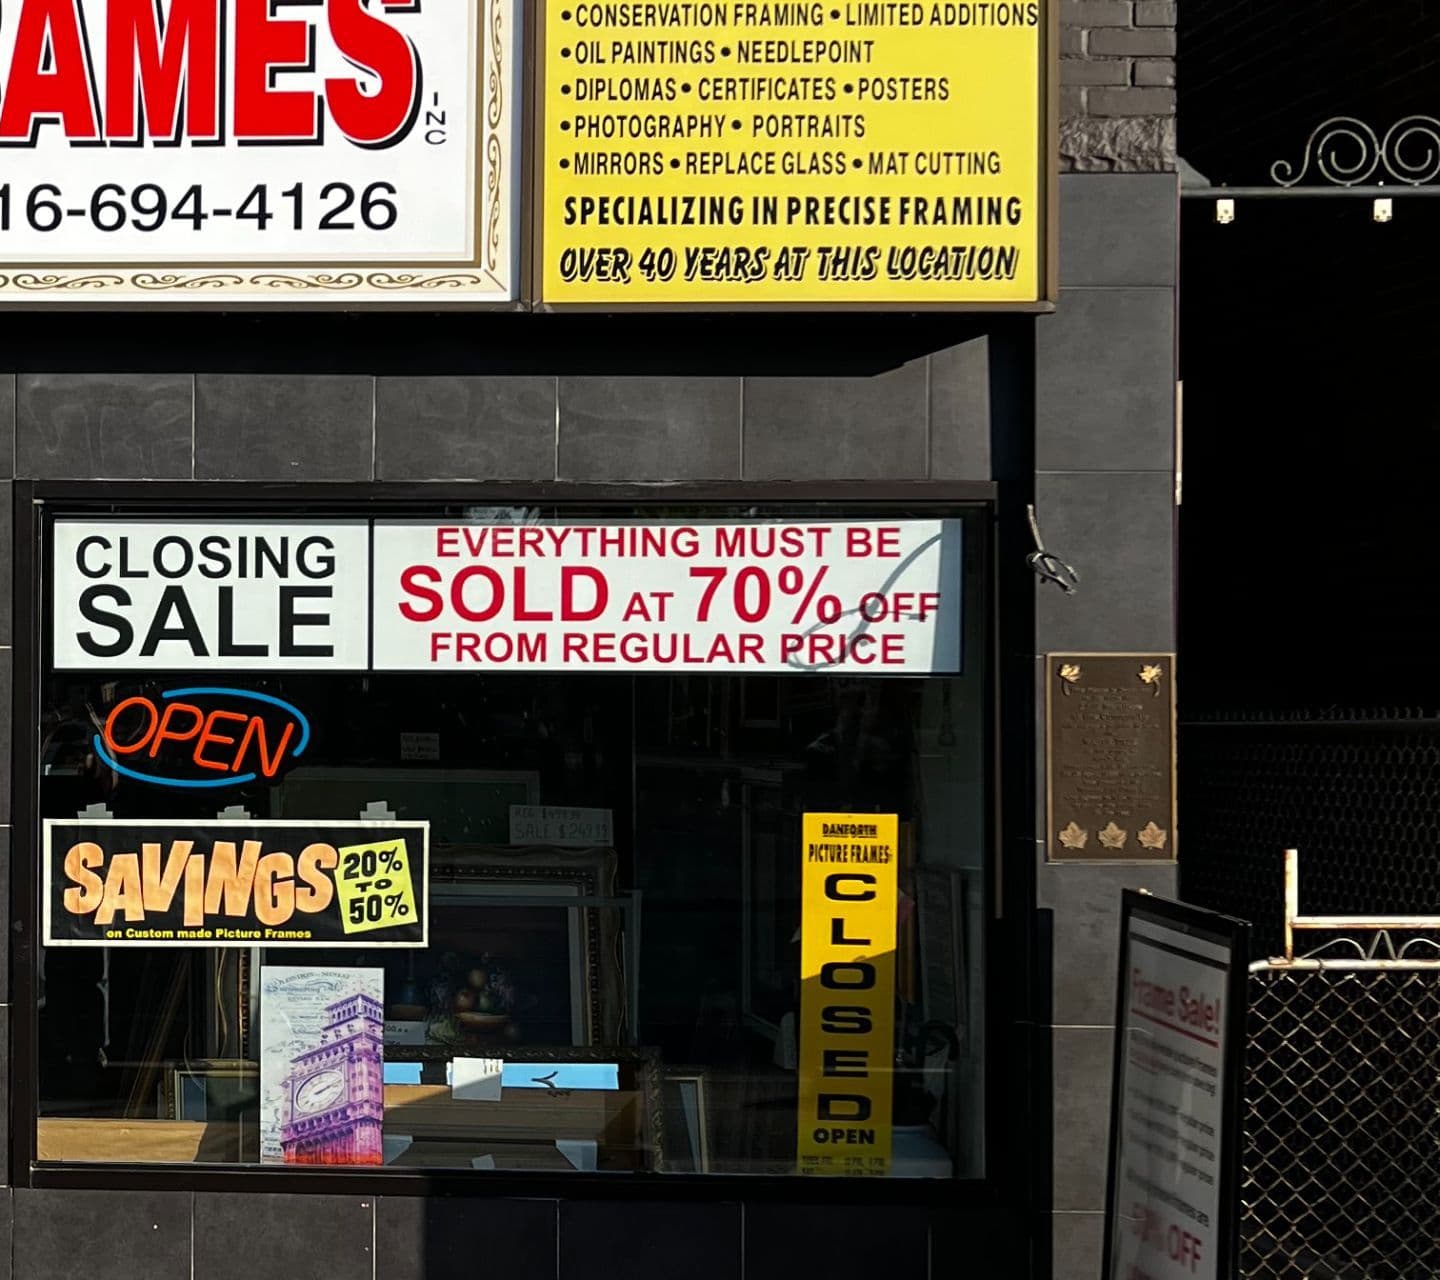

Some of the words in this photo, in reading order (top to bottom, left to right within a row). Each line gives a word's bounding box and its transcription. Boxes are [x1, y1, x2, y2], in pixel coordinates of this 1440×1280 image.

[575, 3, 728, 28] CONSERVATION
[733, 2, 825, 28] FRAMING
[845, 2, 924, 27] LIMITED
[929, 2, 1039, 27] ADDITIONS
[575, 40, 606, 65] OIL
[611, 40, 717, 65] PAINTINGS
[736, 39, 875, 65] NEEDLEPOINT
[575, 77, 677, 102] DIPLOMAS
[697, 76, 837, 102] CERTIFICATES
[857, 76, 951, 102] POSTERS
[425, 91, 447, 146] INC
[574, 115, 727, 139] PHOTOGRAPHY
[751, 114, 866, 139] PORTRAITS
[573, 152, 665, 176] MIRRORS
[685, 151, 776, 176] REPLACE
[780, 151, 848, 176] GLASS
[868, 151, 910, 176] MAT
[914, 151, 1002, 176] CUTTING
[564, 195, 745, 227] SPECIALIZING
[751, 195, 779, 227] IN
[786, 195, 892, 227] PRECISE
[898, 195, 1023, 227] FRAMING
[560, 246, 633, 285] OVER
[638, 246, 678, 284] 40
[683, 245, 771, 285] YEARS
[772, 245, 811, 284] AT
[816, 245, 882, 282] THIS
[886, 245, 1020, 281] LOCATION
[75, 535, 336, 580] CLOSING
[435, 526, 700, 559] EVERYTHING
[714, 526, 832, 558] MUST
[845, 526, 902, 558] BE
[398, 564, 610, 623] SOLD
[622, 591, 675, 622] AT
[688, 564, 843, 626] 70%
[859, 591, 942, 623] OFF
[75, 583, 335, 659] SALE
[430, 632, 548, 664] FROM
[562, 632, 766, 665] REGULAR
[780, 633, 907, 666] PRICE
[103, 696, 296, 778] OPEN
[822, 824, 878, 838] DANFORTH
[343, 846, 404, 880] 20%
[808, 843, 848, 863] PICTURE
[850, 844, 890, 864] FRAMES
[63, 839, 339, 928] SAVINGS
[355, 879, 393, 893] TO
[349, 891, 410, 925] 50%
[106, 930, 122, 939] on
[125, 928, 174, 939] Custom
[177, 928, 213, 939] made
[215, 928, 262, 939] Picture
[264, 928, 312, 939] Frames
[816, 872, 877, 1122] CLOSED
[813, 1127, 875, 1145] OPEN
